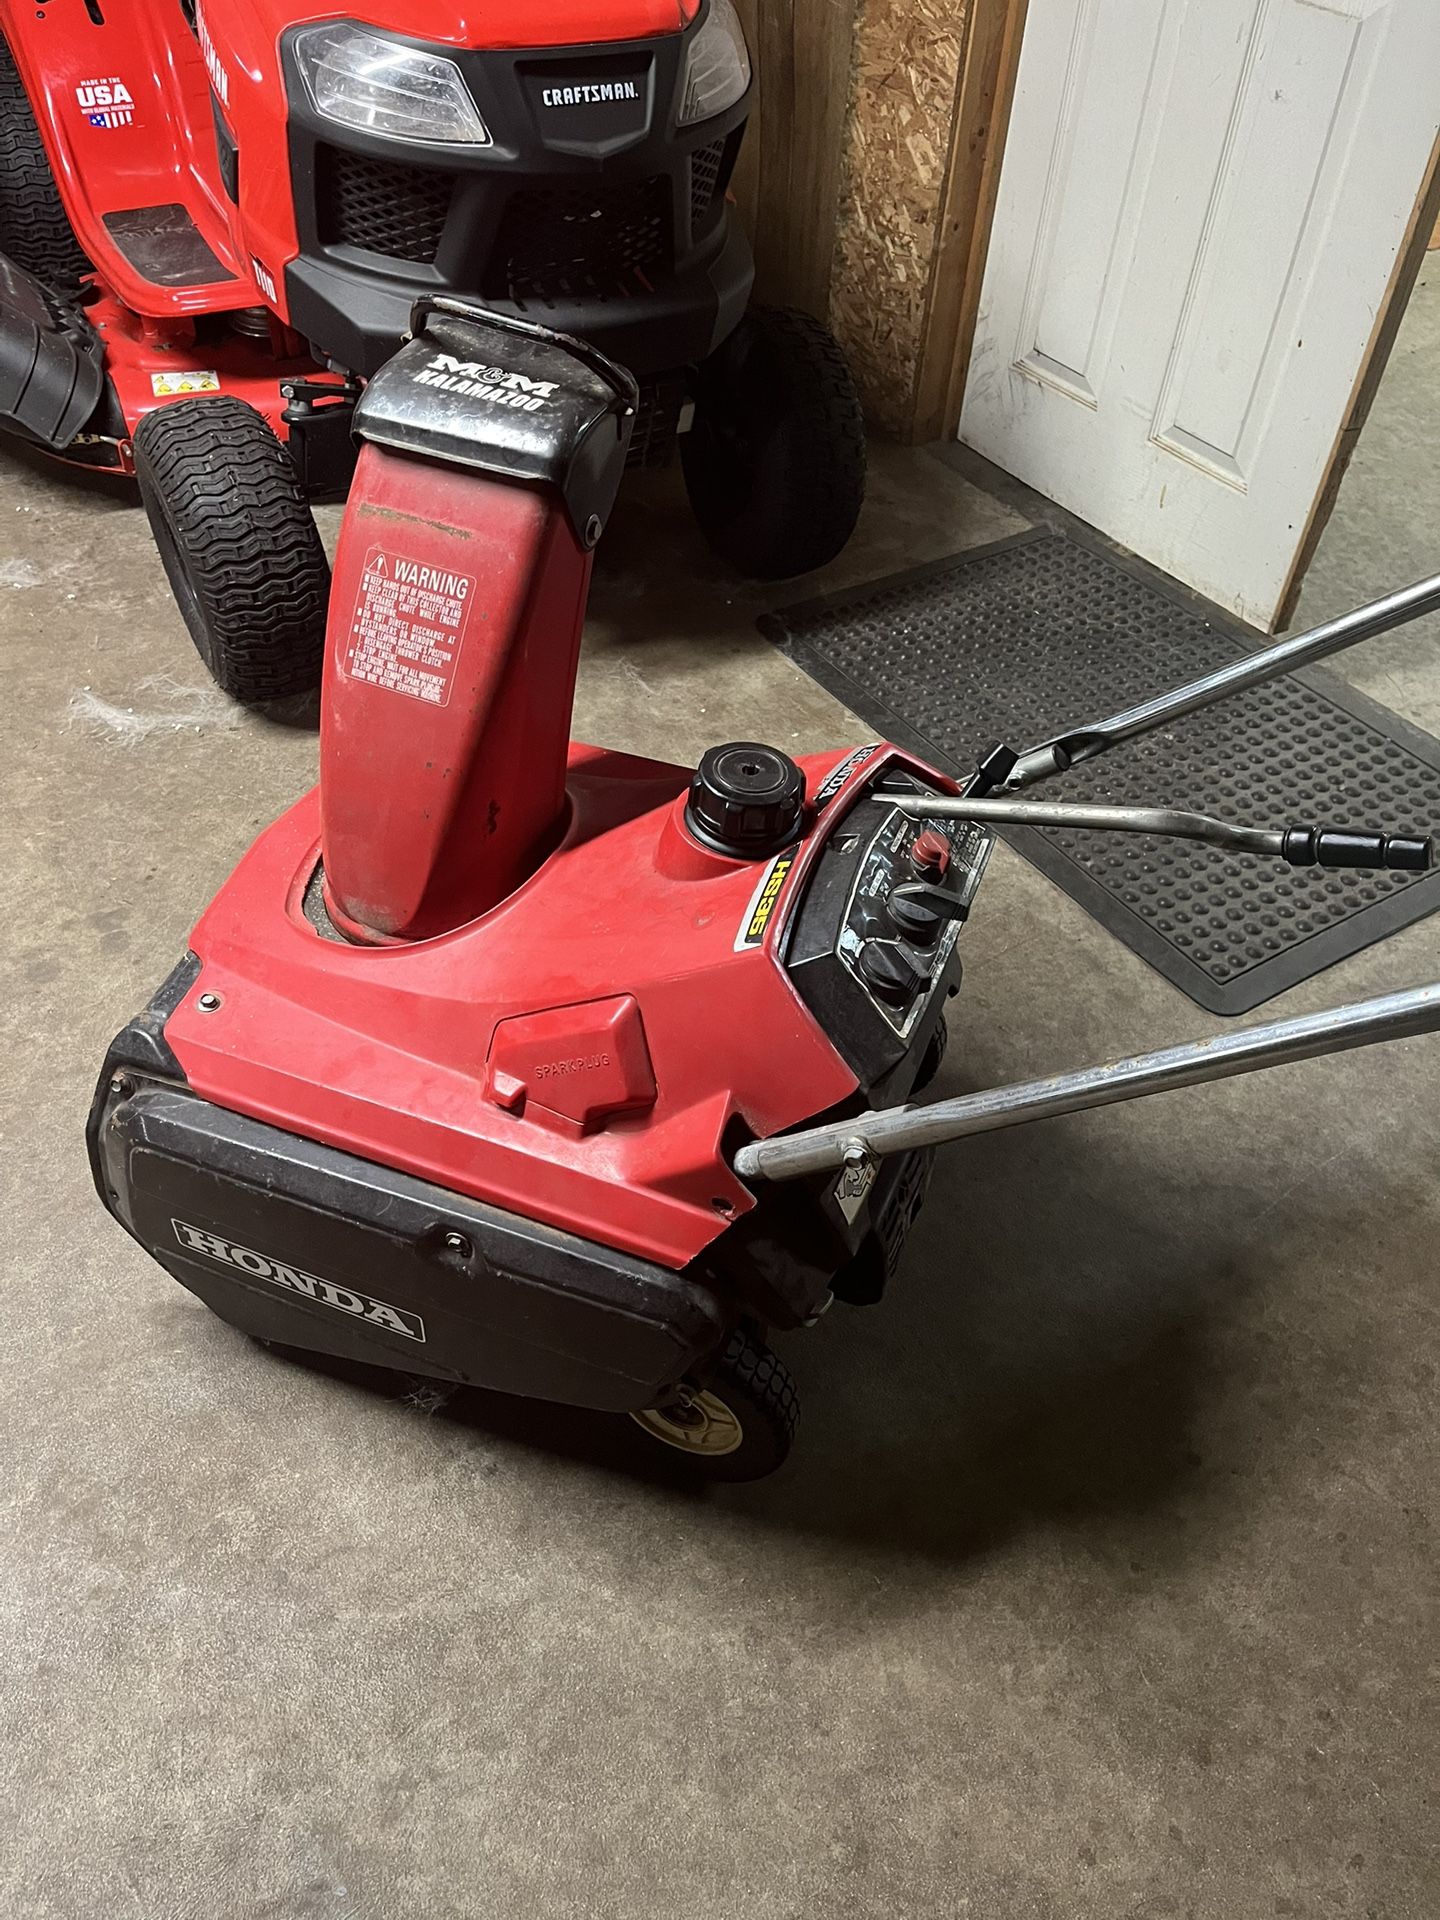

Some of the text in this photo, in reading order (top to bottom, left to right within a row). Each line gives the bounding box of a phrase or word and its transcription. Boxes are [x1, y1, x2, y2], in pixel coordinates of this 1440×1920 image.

[76, 84, 133, 107] USA
[412, 369, 545, 412] KALAMAZOO
[426, 352, 560, 398] M&M
[395, 559, 468, 599] WARNING
[748, 860, 792, 936] HS35
[182, 1225, 416, 1336] HONDA
